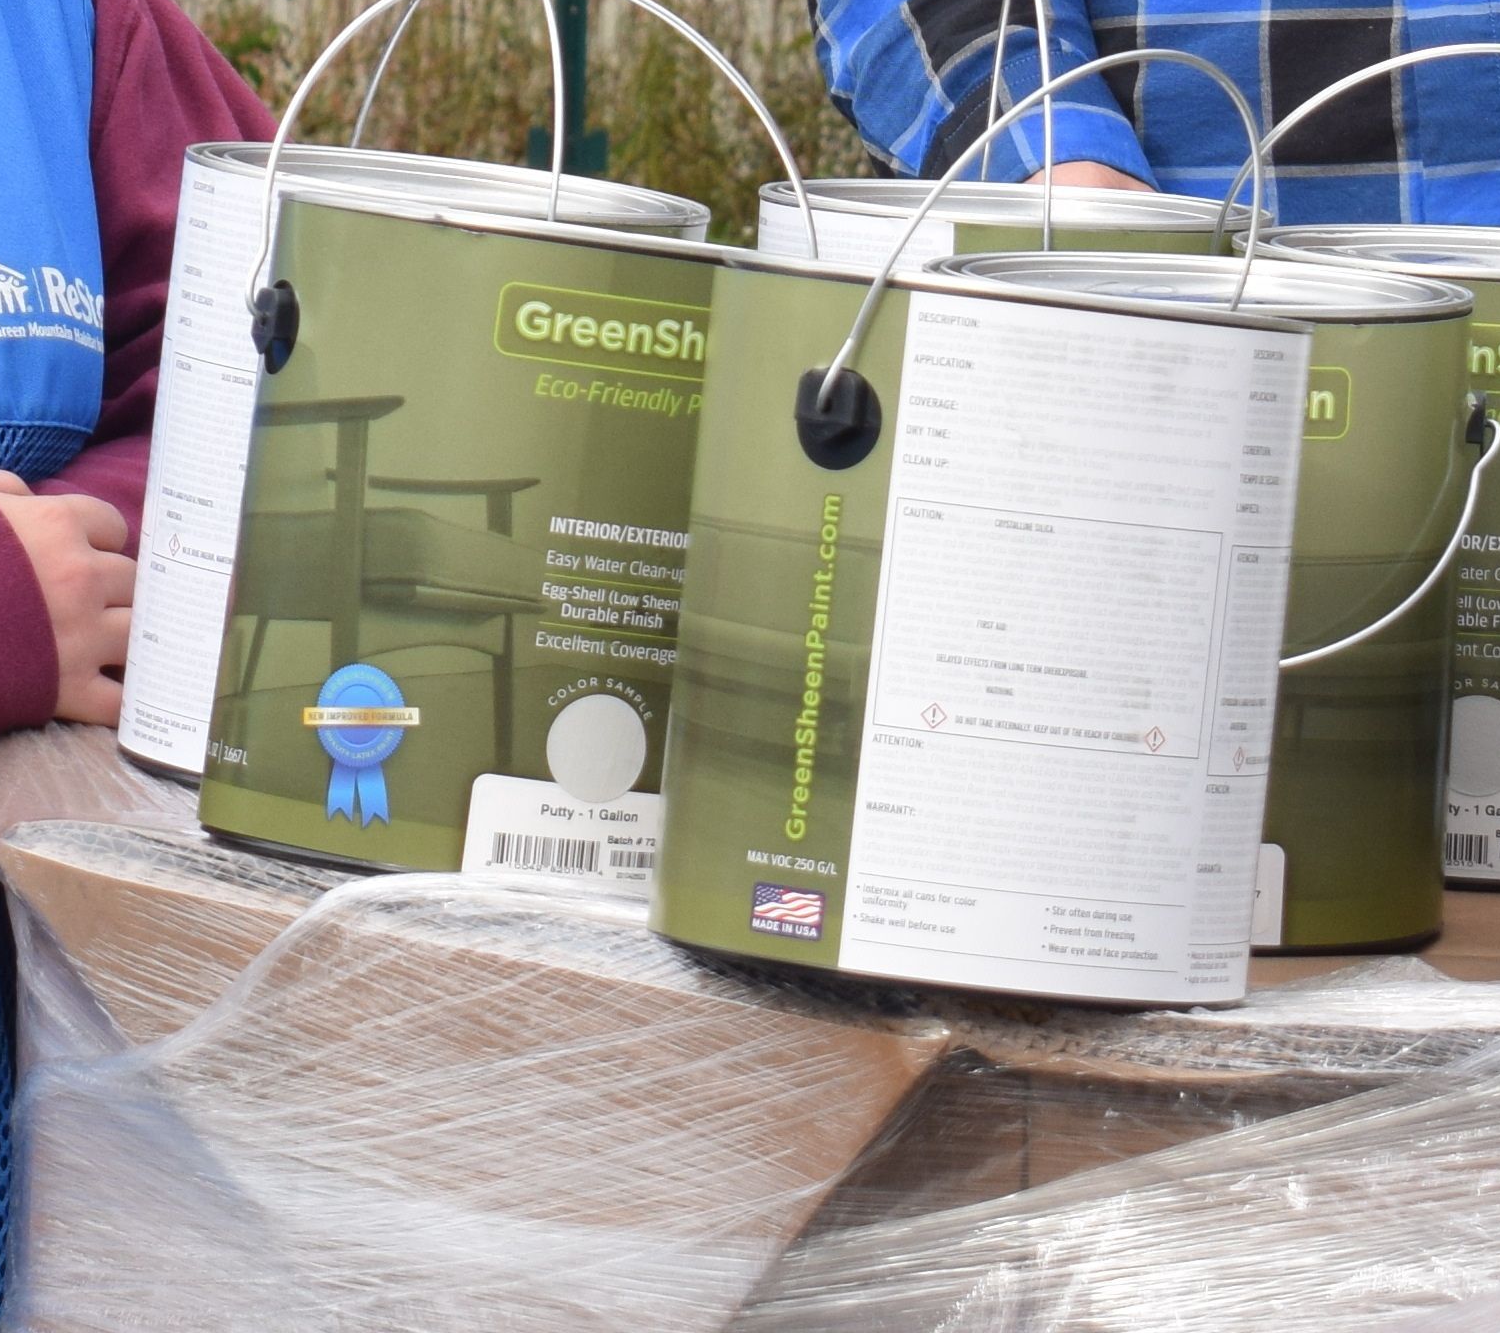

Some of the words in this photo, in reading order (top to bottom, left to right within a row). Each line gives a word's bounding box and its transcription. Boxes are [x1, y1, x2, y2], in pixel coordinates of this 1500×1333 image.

[41, 266, 105, 330] ReSto
[917, 311, 981, 329] DESCRIPTION:
[27, 321, 75, 341] Mountain
[515, 300, 706, 362] GreenSh
[913, 353, 976, 371] APPLICATION:
[534, 373, 683, 418] Eco-Friendly
[908, 395, 960, 411] COVERAGE:
[905, 424, 923, 436] DRY
[926, 426, 951, 439] TIME:
[902, 453, 933, 467] CLEAN
[903, 505, 946, 522] CAUTION:
[546, 549, 580, 570] Easy
[585, 555, 627, 574] Water
[1461, 566, 1490, 581] ater
[542, 582, 606, 603] Egg-Shell
[608, 589, 639, 607] (Low
[561, 602, 618, 624] Durable
[622, 610, 664, 629] Finish
[1457, 613, 1488, 628] able
[535, 630, 606, 655] Excellent
[610, 640, 678, 666] Coverage
[783, 492, 842, 843] GreenSheenPaint.com
[963, 656, 990, 668] EFFECTS
[547, 676, 599, 707] COLOR
[605, 677, 654, 721] SAMPLE
[872, 733, 925, 749] ATTENTION:
[541, 804, 576, 821] Putty
[598, 809, 639, 823] Gallon
[865, 801, 917, 817] WARRANTY:
[607, 835, 634, 846] Batch
[747, 849, 770, 864] MAX
[770, 852, 793, 869] VOC
[793, 856, 816, 872] 250
[817, 859, 838, 876] G/L
[862, 883, 899, 898] Intermix
[901, 889, 913, 900] all
[914, 893, 936, 903] cans
[938, 892, 952, 904] for
[954, 895, 977, 907] color
[862, 896, 909, 911] uniformity
[859, 912, 885, 926] Shake
[888, 916, 906, 928] well
[908, 918, 938, 932] before
[939, 923, 957, 934] use
[1051, 905, 1067, 917] Stir
[1068, 907, 1091, 920] often
[1092, 910, 1118, 923] during
[1118, 913, 1133, 922] use
[751, 917, 780, 932] MADE
[781, 921, 794, 933] IN
[794, 924, 818, 938] USA
[1049, 924, 1082, 937] Prevent
[1083, 926, 1103, 939] from
[1104, 928, 1136, 942] freezing
[1047, 943, 1067, 954] Wear
[1070, 945, 1085, 957] eye
[1086, 945, 1102, 956] and
[1103, 947, 1120, 958] face
[1120, 949, 1159, 961] protection
